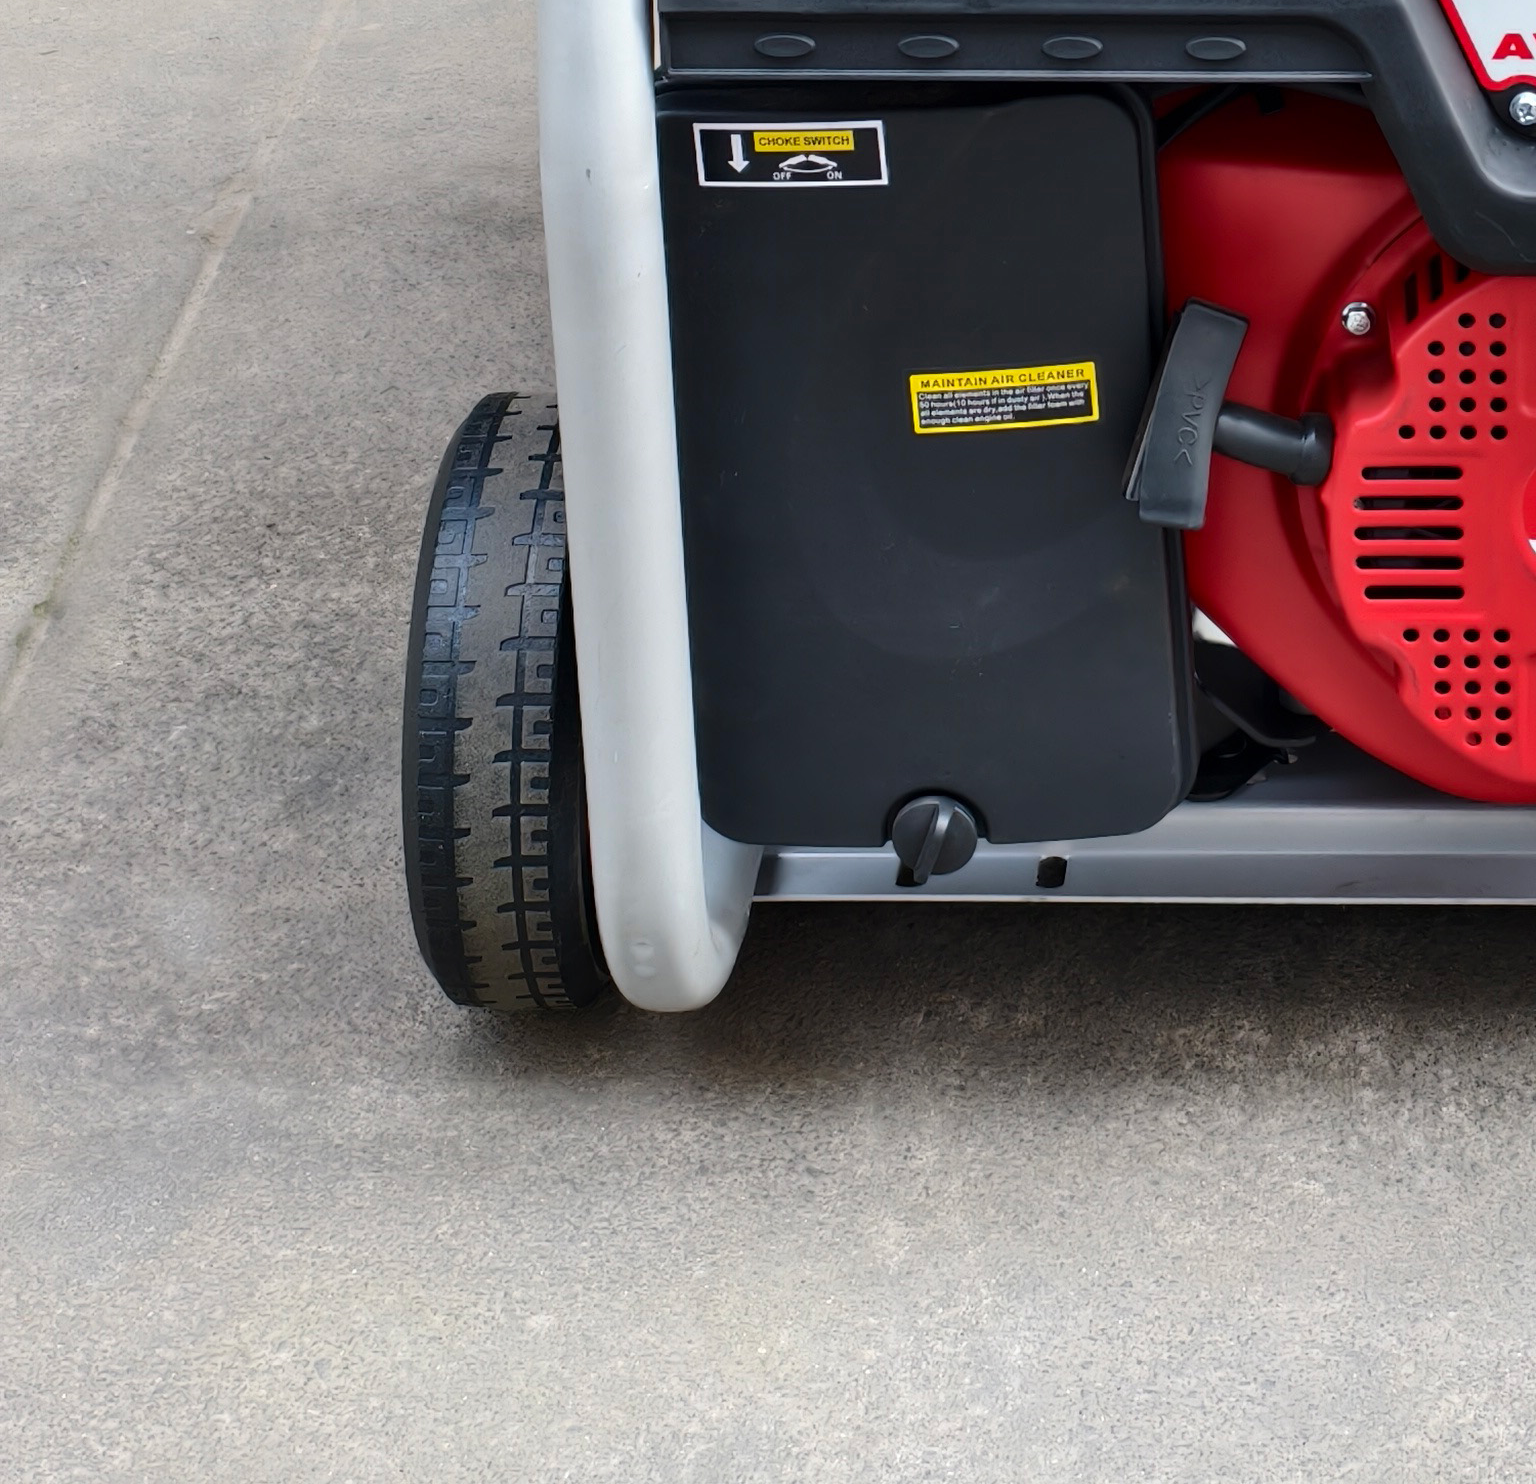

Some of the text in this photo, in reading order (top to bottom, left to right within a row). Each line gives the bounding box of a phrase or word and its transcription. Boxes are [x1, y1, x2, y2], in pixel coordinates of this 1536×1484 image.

[759, 135, 850, 146] CHOKE SWITCH
[772, 171, 792, 181] OFF
[826, 171, 843, 180] ON
[920, 368, 1085, 389] MAINTAIN AIR CLEANER
